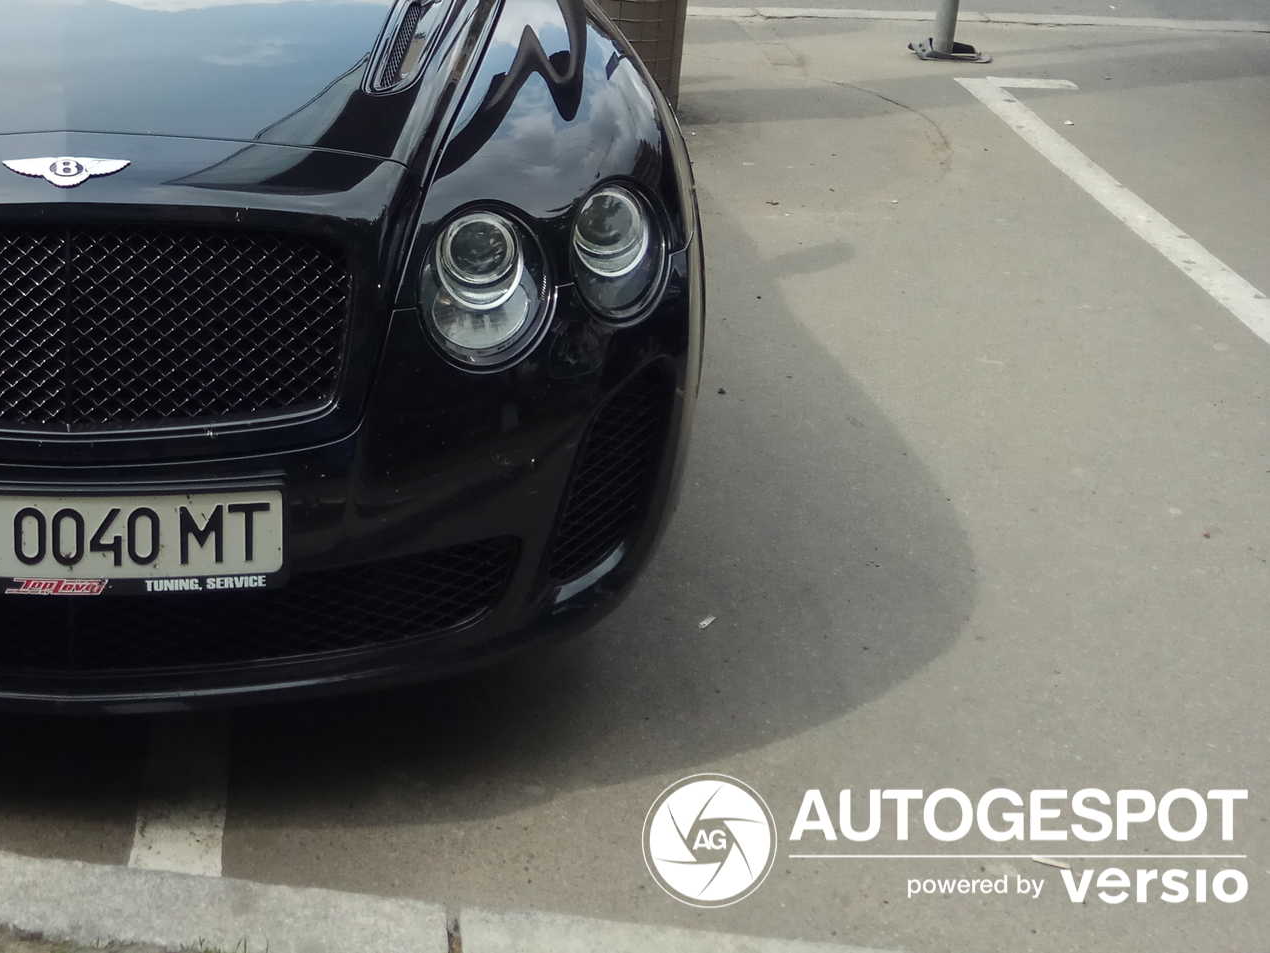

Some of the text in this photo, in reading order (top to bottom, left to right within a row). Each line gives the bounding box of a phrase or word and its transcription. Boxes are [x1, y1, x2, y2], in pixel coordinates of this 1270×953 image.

[13, 506, 161, 567] 0040
[179, 502, 271, 565] MT
[145, 575, 267, 591] TUNING, SERVICE
